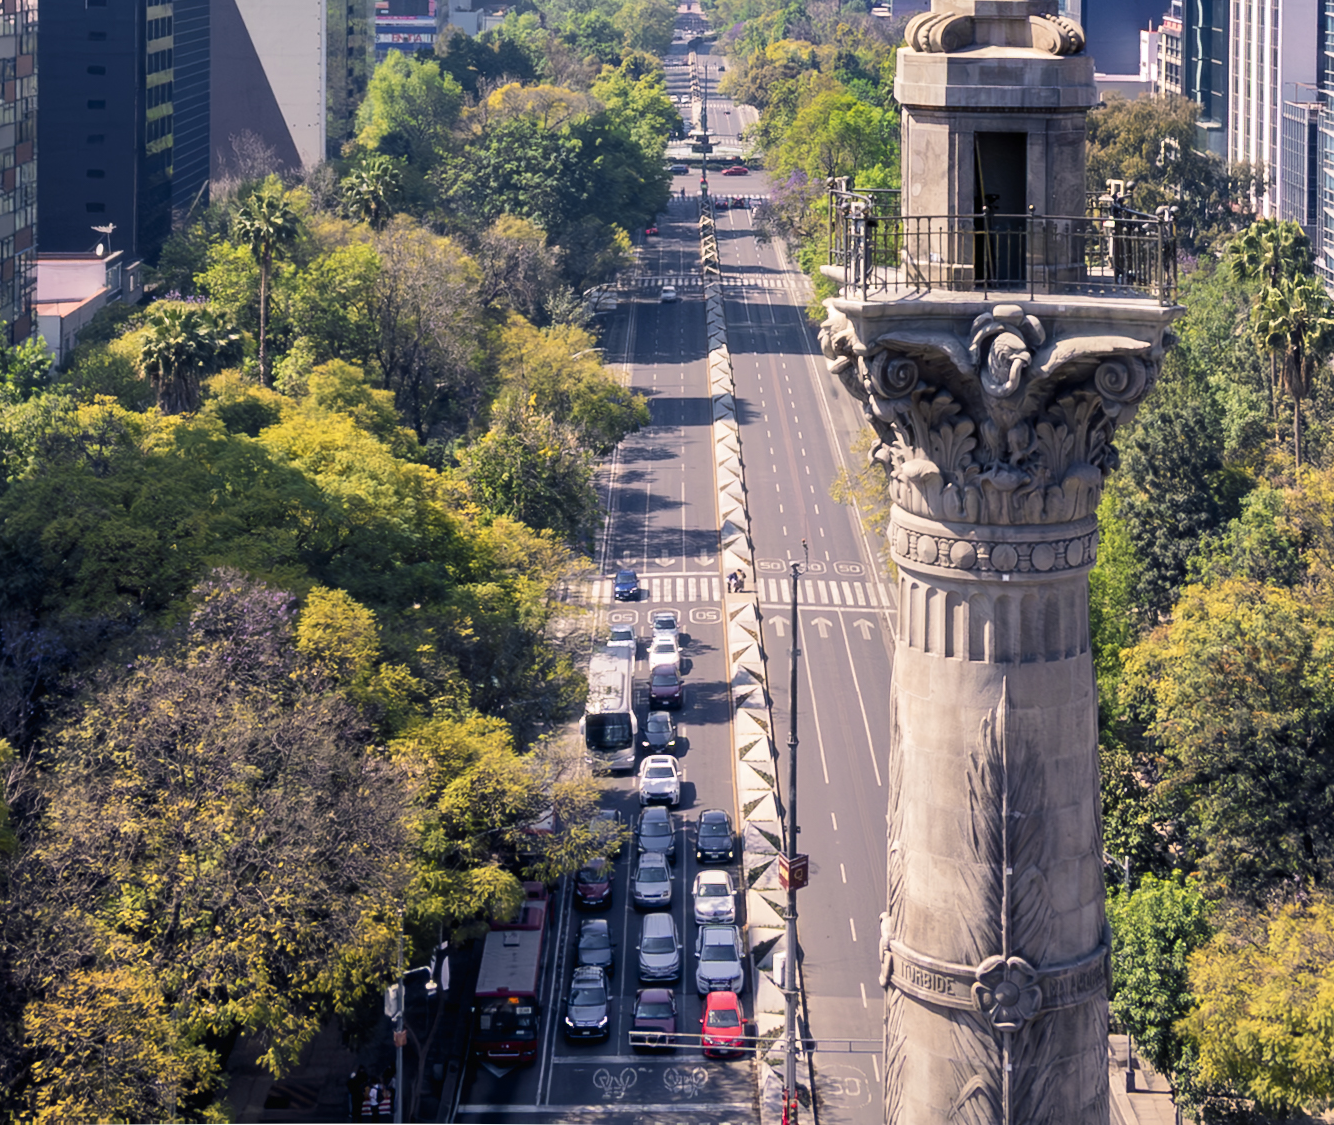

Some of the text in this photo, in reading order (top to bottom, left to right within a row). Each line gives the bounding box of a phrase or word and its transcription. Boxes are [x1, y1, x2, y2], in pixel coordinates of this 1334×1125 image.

[759, 561, 781, 570] 50
[838, 564, 861, 573] 50
[901, 961, 956, 997] ITURBIDE
